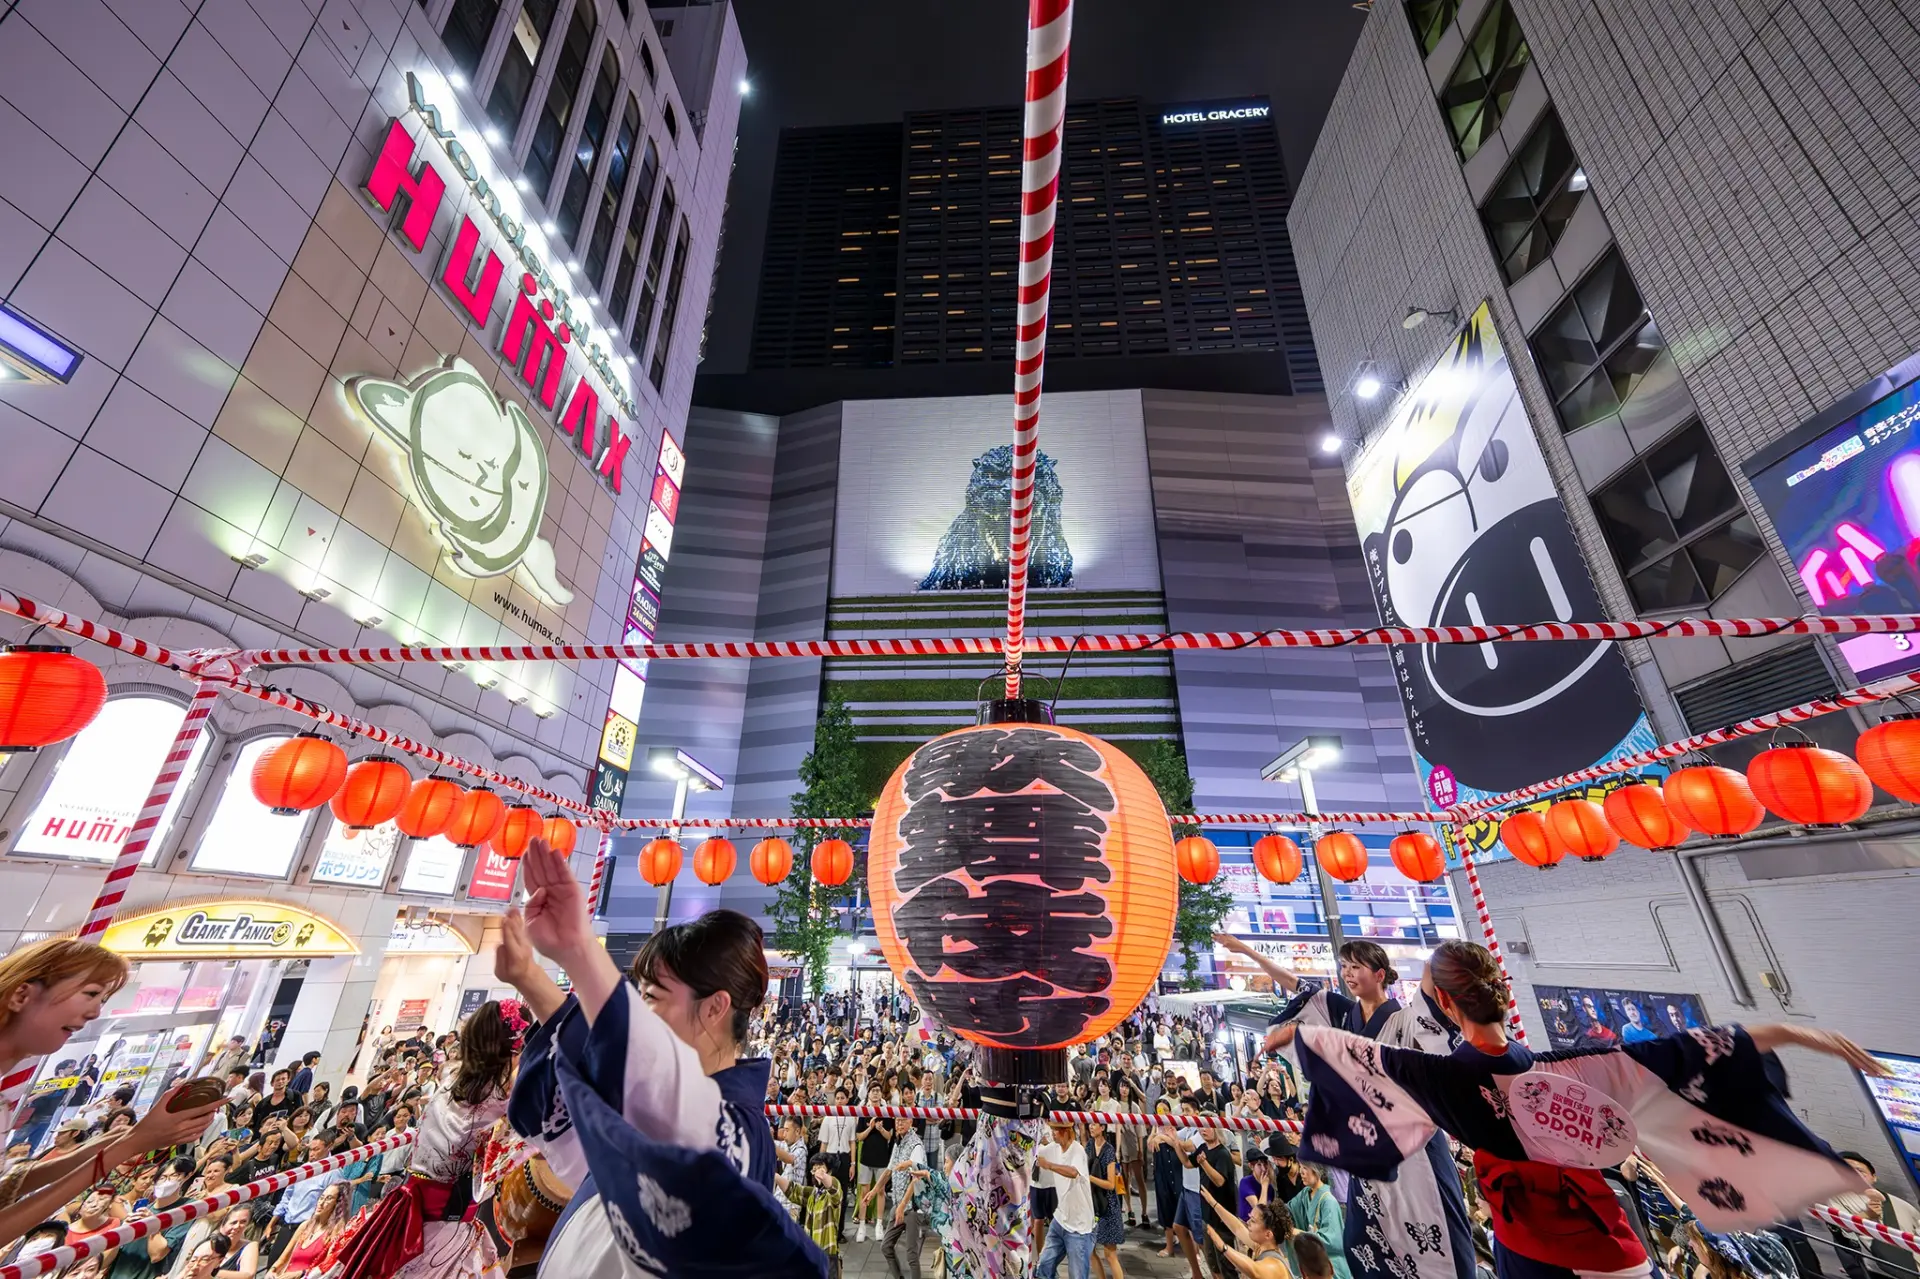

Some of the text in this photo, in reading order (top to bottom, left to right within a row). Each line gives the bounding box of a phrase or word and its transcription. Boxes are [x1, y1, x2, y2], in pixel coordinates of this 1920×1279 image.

[1163, 106, 1269, 124] HOTEL GRACERY
[1863, 400, 1920, 438] 音楽チャン
[494, 591, 573, 647] www.humax.co
[593, 794, 619, 813] SAUNA
[42, 816, 131, 844] HUMA
[318, 860, 382, 881] ボウリング
[181, 912, 231, 940] GAME
[1549, 1101, 1593, 1130] BON
[1534, 1111, 1604, 1150] ODORI
